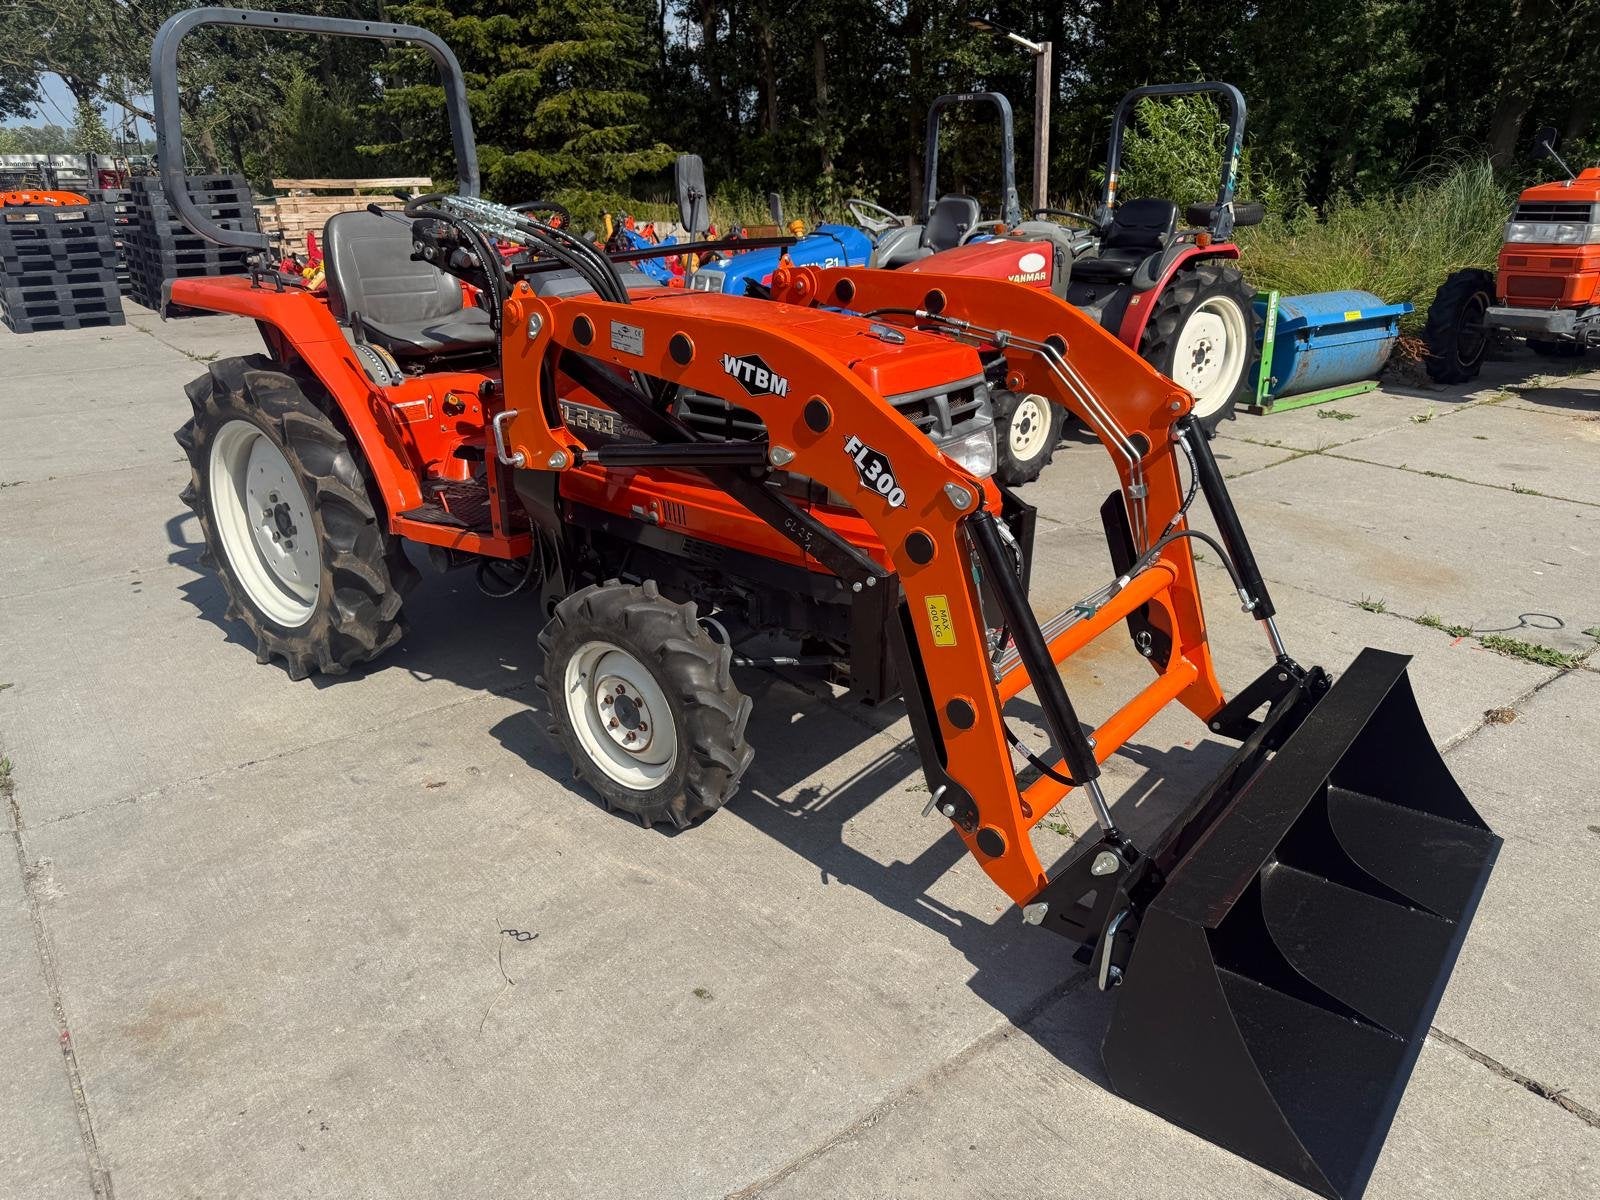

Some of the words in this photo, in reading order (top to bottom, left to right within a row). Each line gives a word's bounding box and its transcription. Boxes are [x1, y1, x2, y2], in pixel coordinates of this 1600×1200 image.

[825, 257, 839, 269] 21
[1008, 271, 1047, 283] YANMAR
[723, 354, 788, 397] WTBM
[844, 435, 906, 507] FL300
[930, 604, 939, 622] 400
[935, 624, 943, 638] KG
[940, 609, 950, 631] MAX
